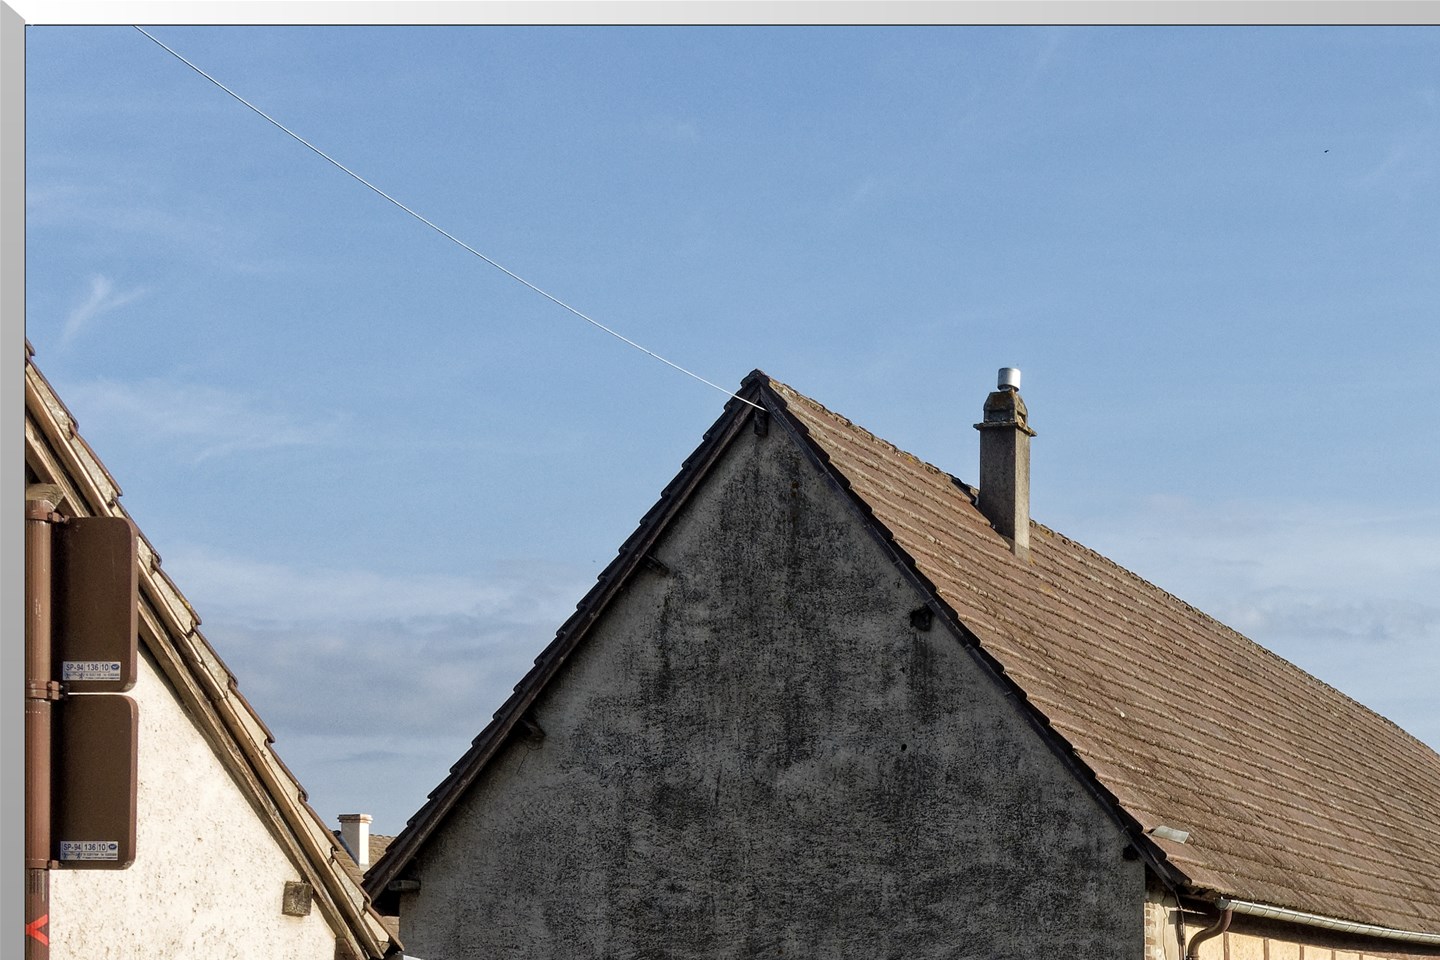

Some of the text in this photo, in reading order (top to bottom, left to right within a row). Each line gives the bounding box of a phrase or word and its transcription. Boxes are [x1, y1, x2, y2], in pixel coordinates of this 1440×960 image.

[65, 663, 84, 671] SP-94
[87, 663, 99, 671] 136
[101, 663, 109, 671] 10
[63, 843, 82, 851] SP-94
[84, 843, 96, 851] 136
[98, 843, 106, 851] 10
